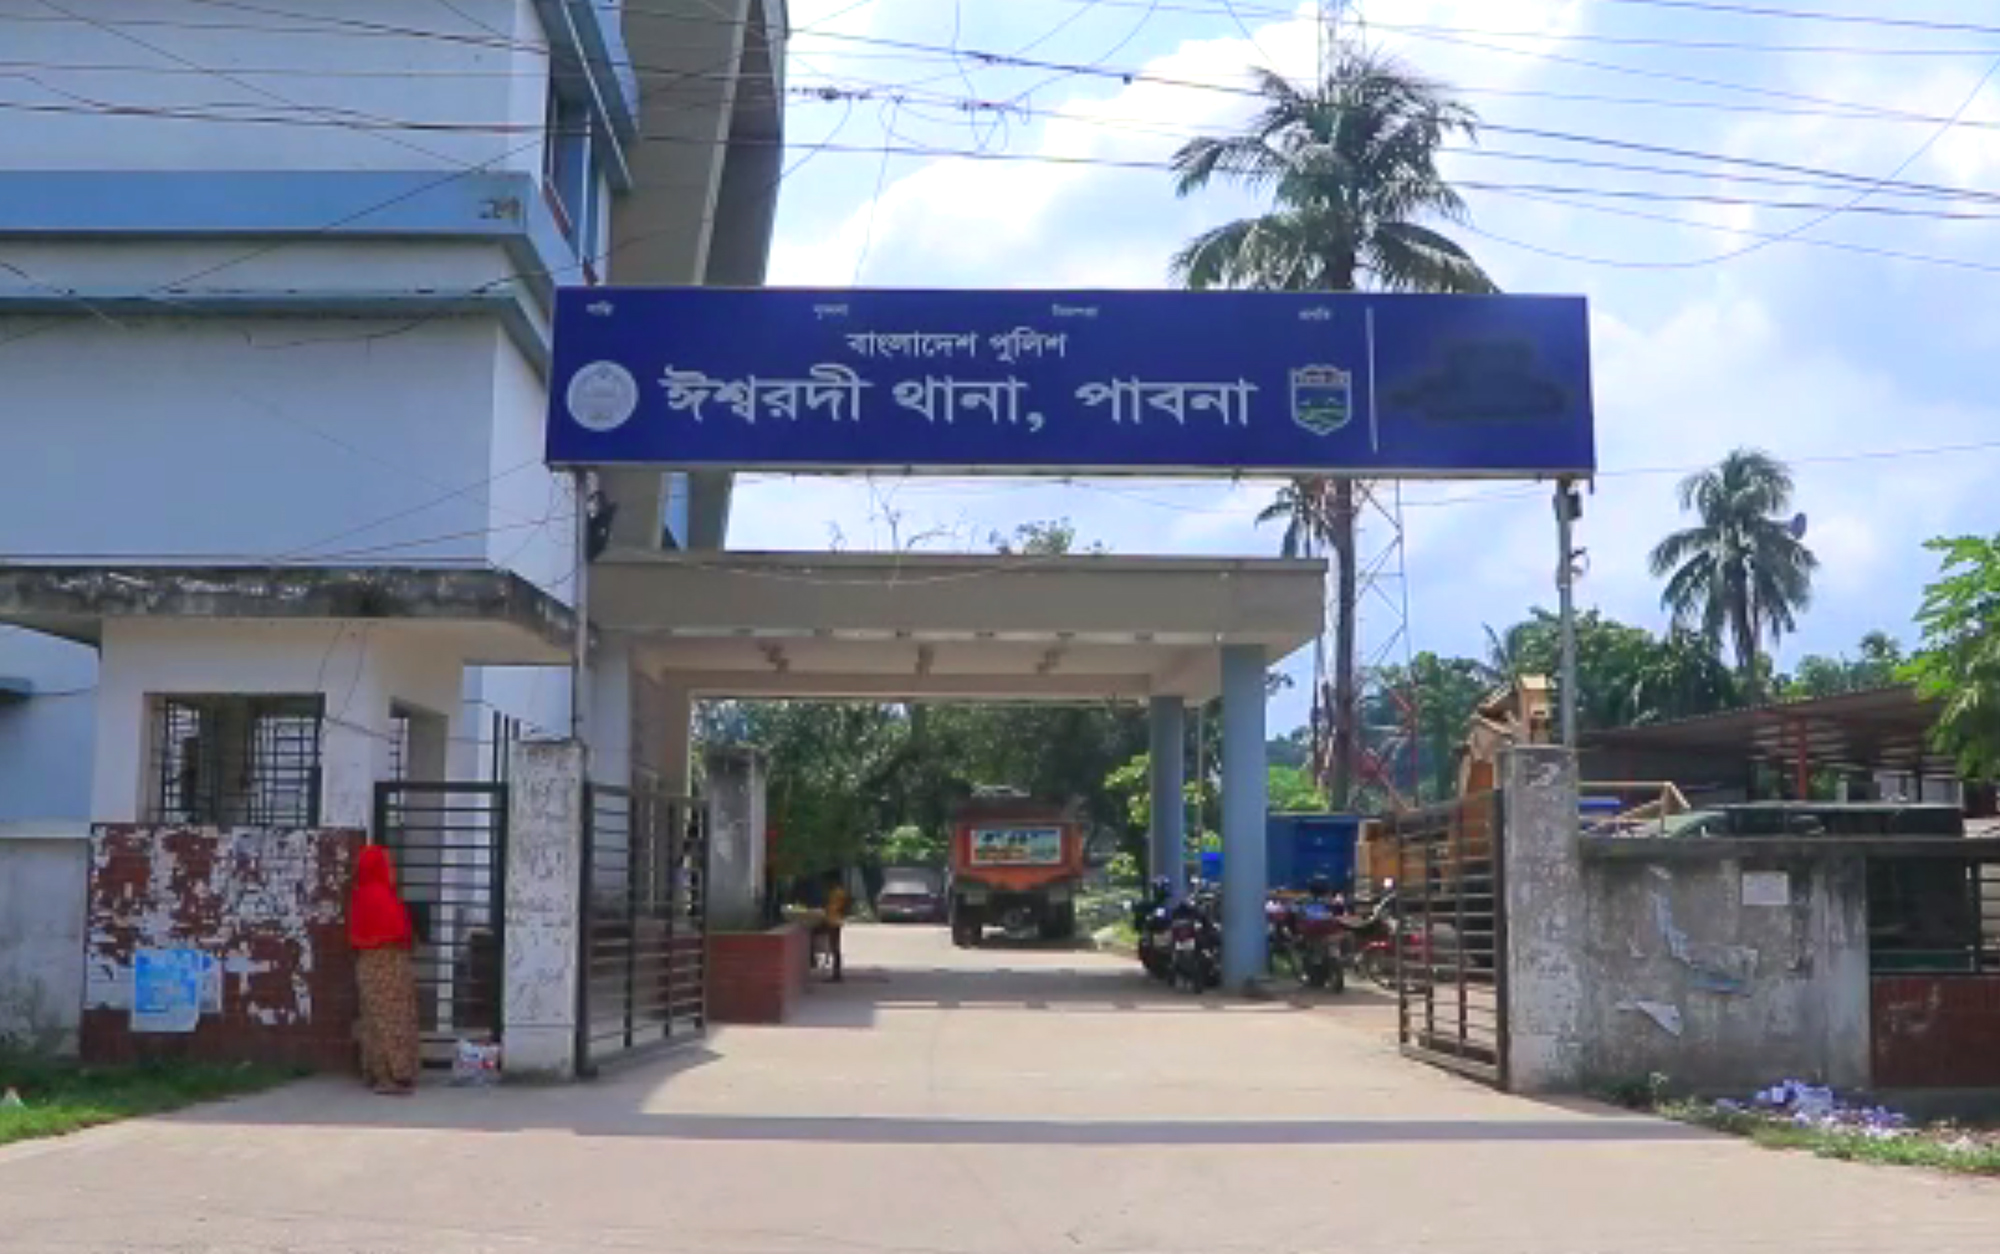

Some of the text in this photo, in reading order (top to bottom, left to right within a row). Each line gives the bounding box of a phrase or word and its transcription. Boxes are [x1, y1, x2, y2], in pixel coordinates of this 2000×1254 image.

[845, 325, 1067, 364] বাংলাদেশ পুলিশ
[658, 362, 1260, 433] ঈশ্বরদী থানা, পাবনা
